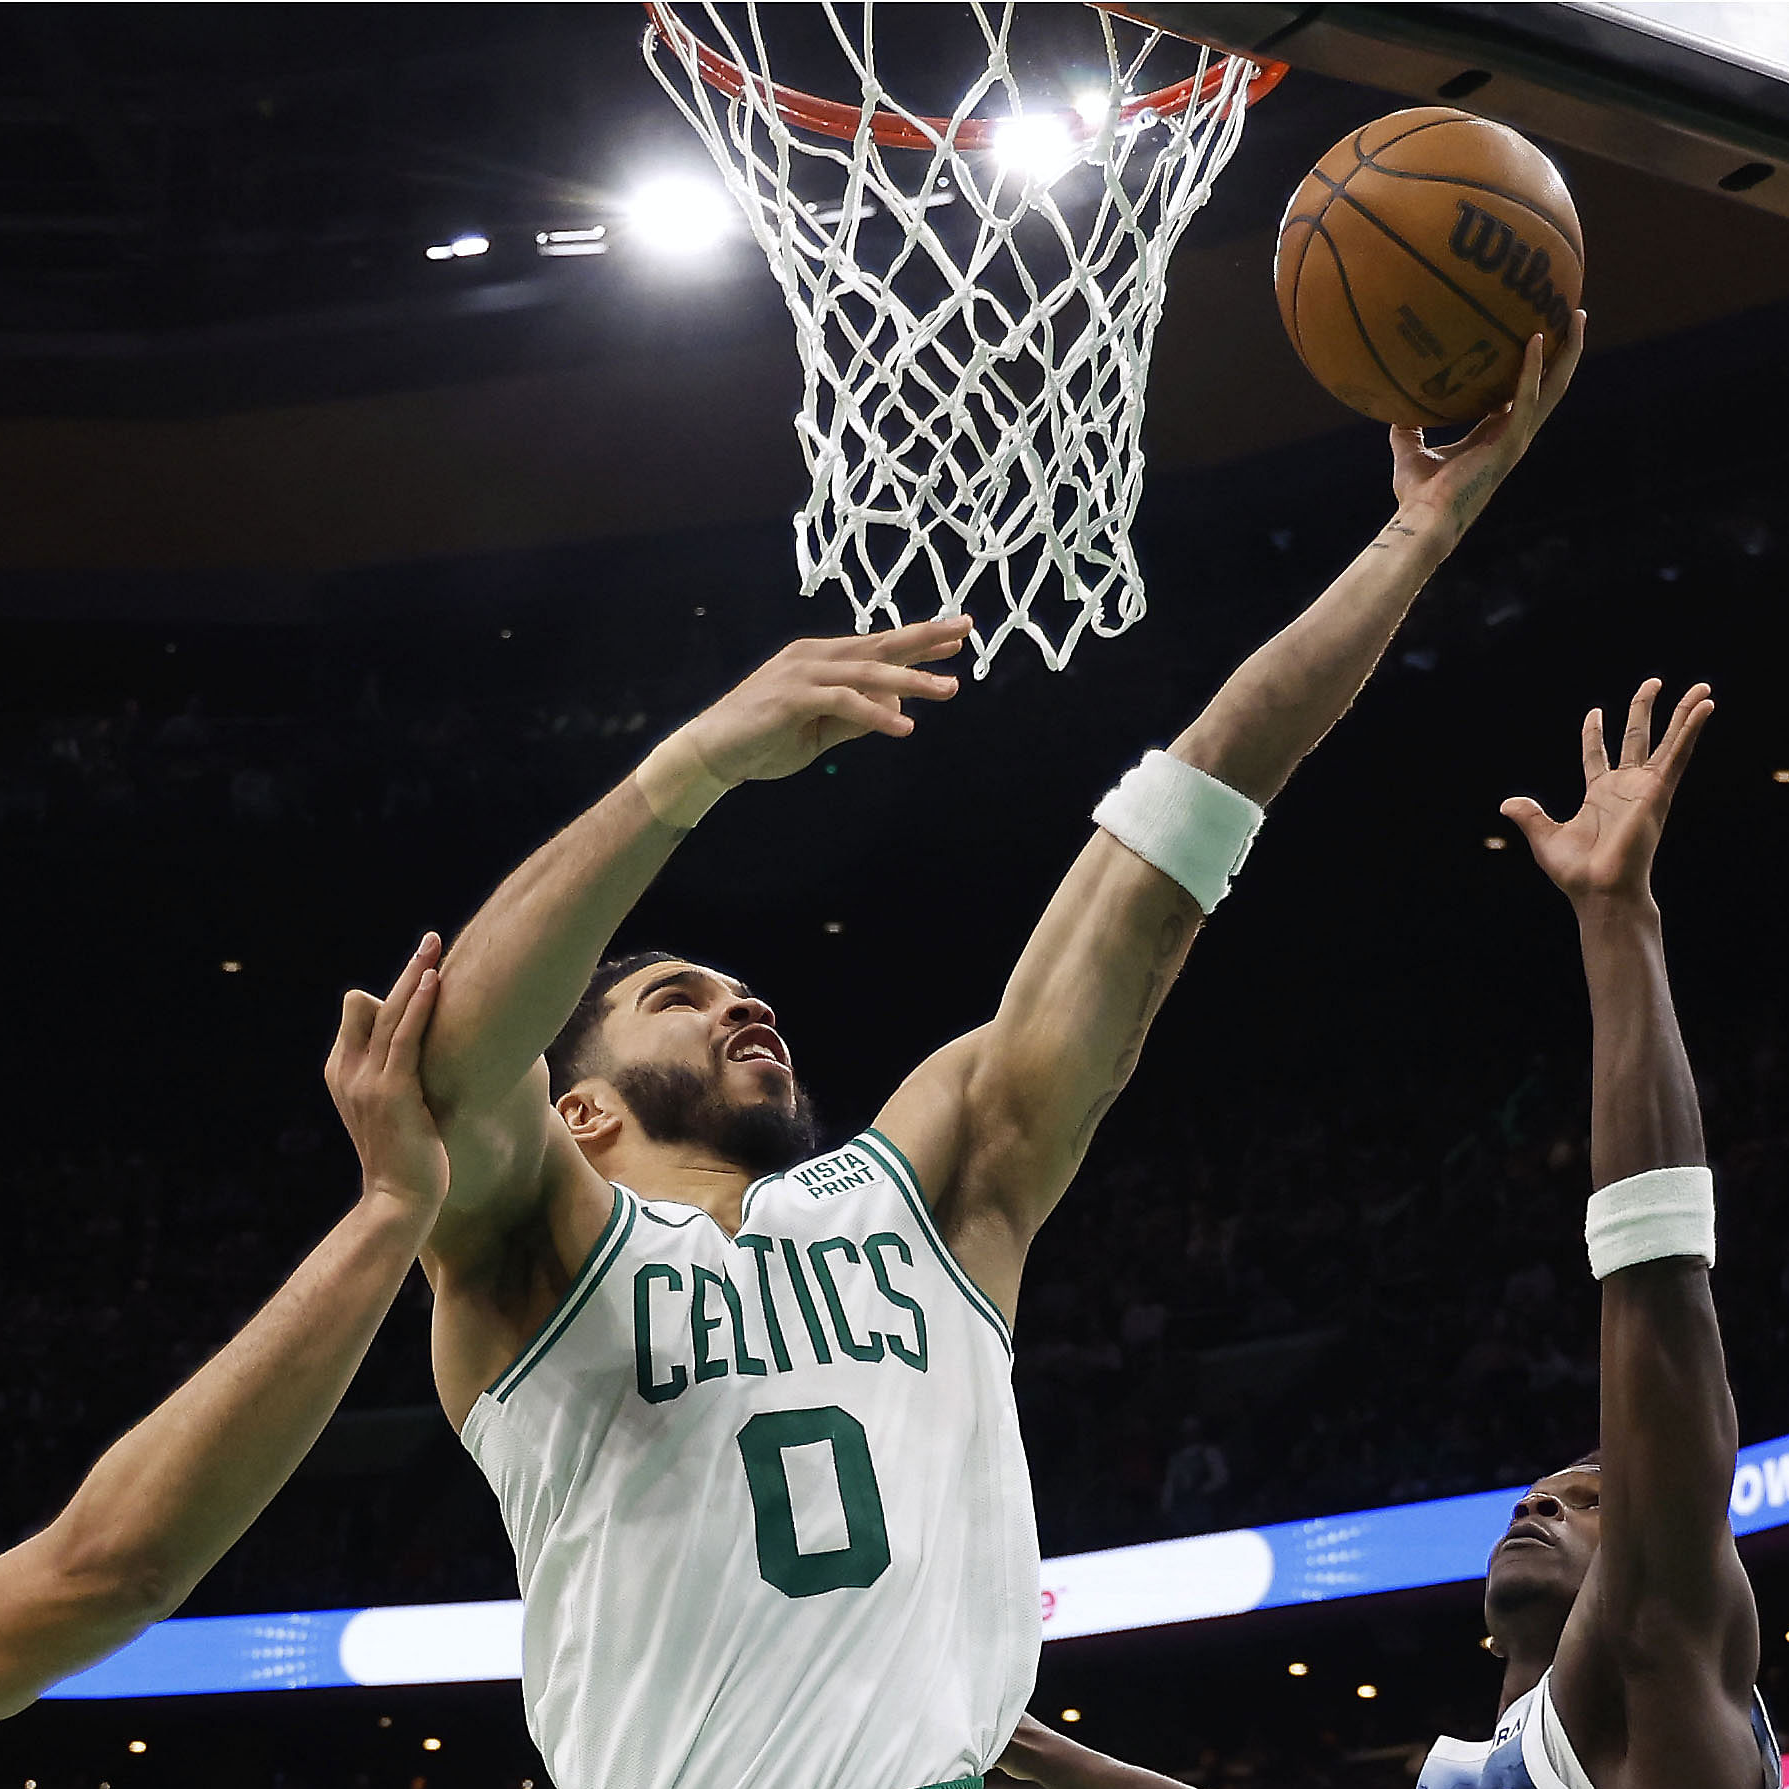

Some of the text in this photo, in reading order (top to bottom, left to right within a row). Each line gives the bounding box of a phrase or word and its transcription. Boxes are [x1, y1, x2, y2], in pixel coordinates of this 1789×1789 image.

[793, 1152, 866, 1186] VISTA
[808, 1165, 875, 1200] PRINT
[633, 1231, 928, 1405] CELTICS
[736, 1405, 892, 1599] 0
